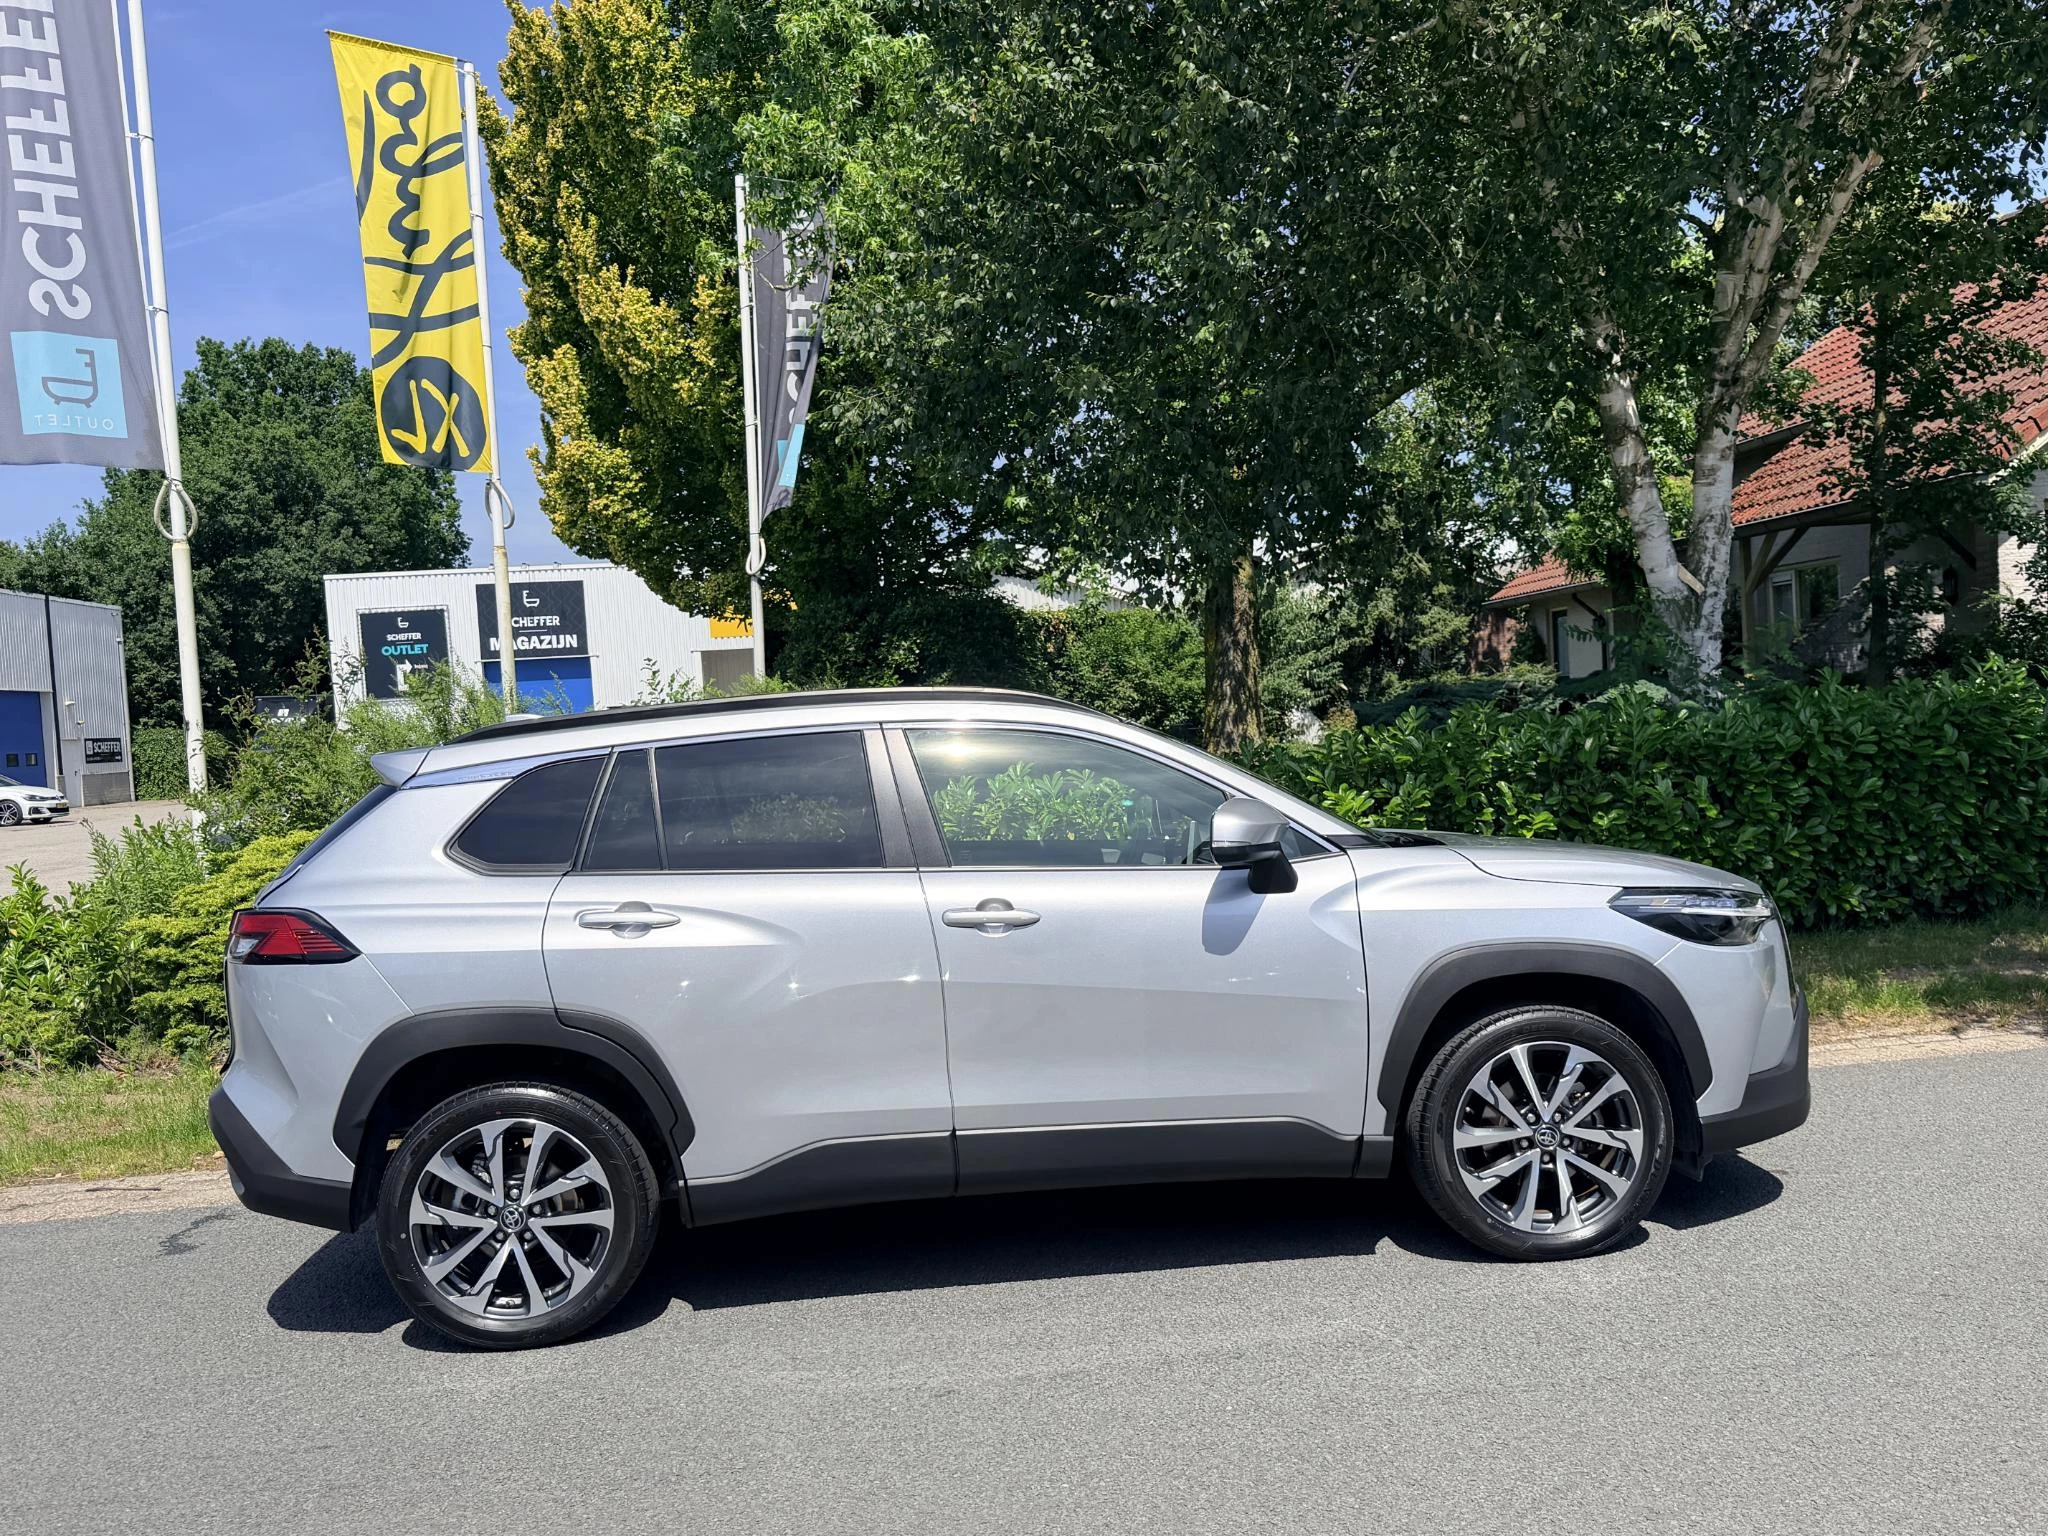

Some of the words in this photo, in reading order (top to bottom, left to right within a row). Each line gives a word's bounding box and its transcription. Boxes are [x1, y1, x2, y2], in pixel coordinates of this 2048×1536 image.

[511, 616, 561, 628] CHEFFER
[386, 632, 422, 641] SCHEFFER
[381, 643, 429, 656] OUTLET
[94, 741, 122, 753] SCHEFFER
